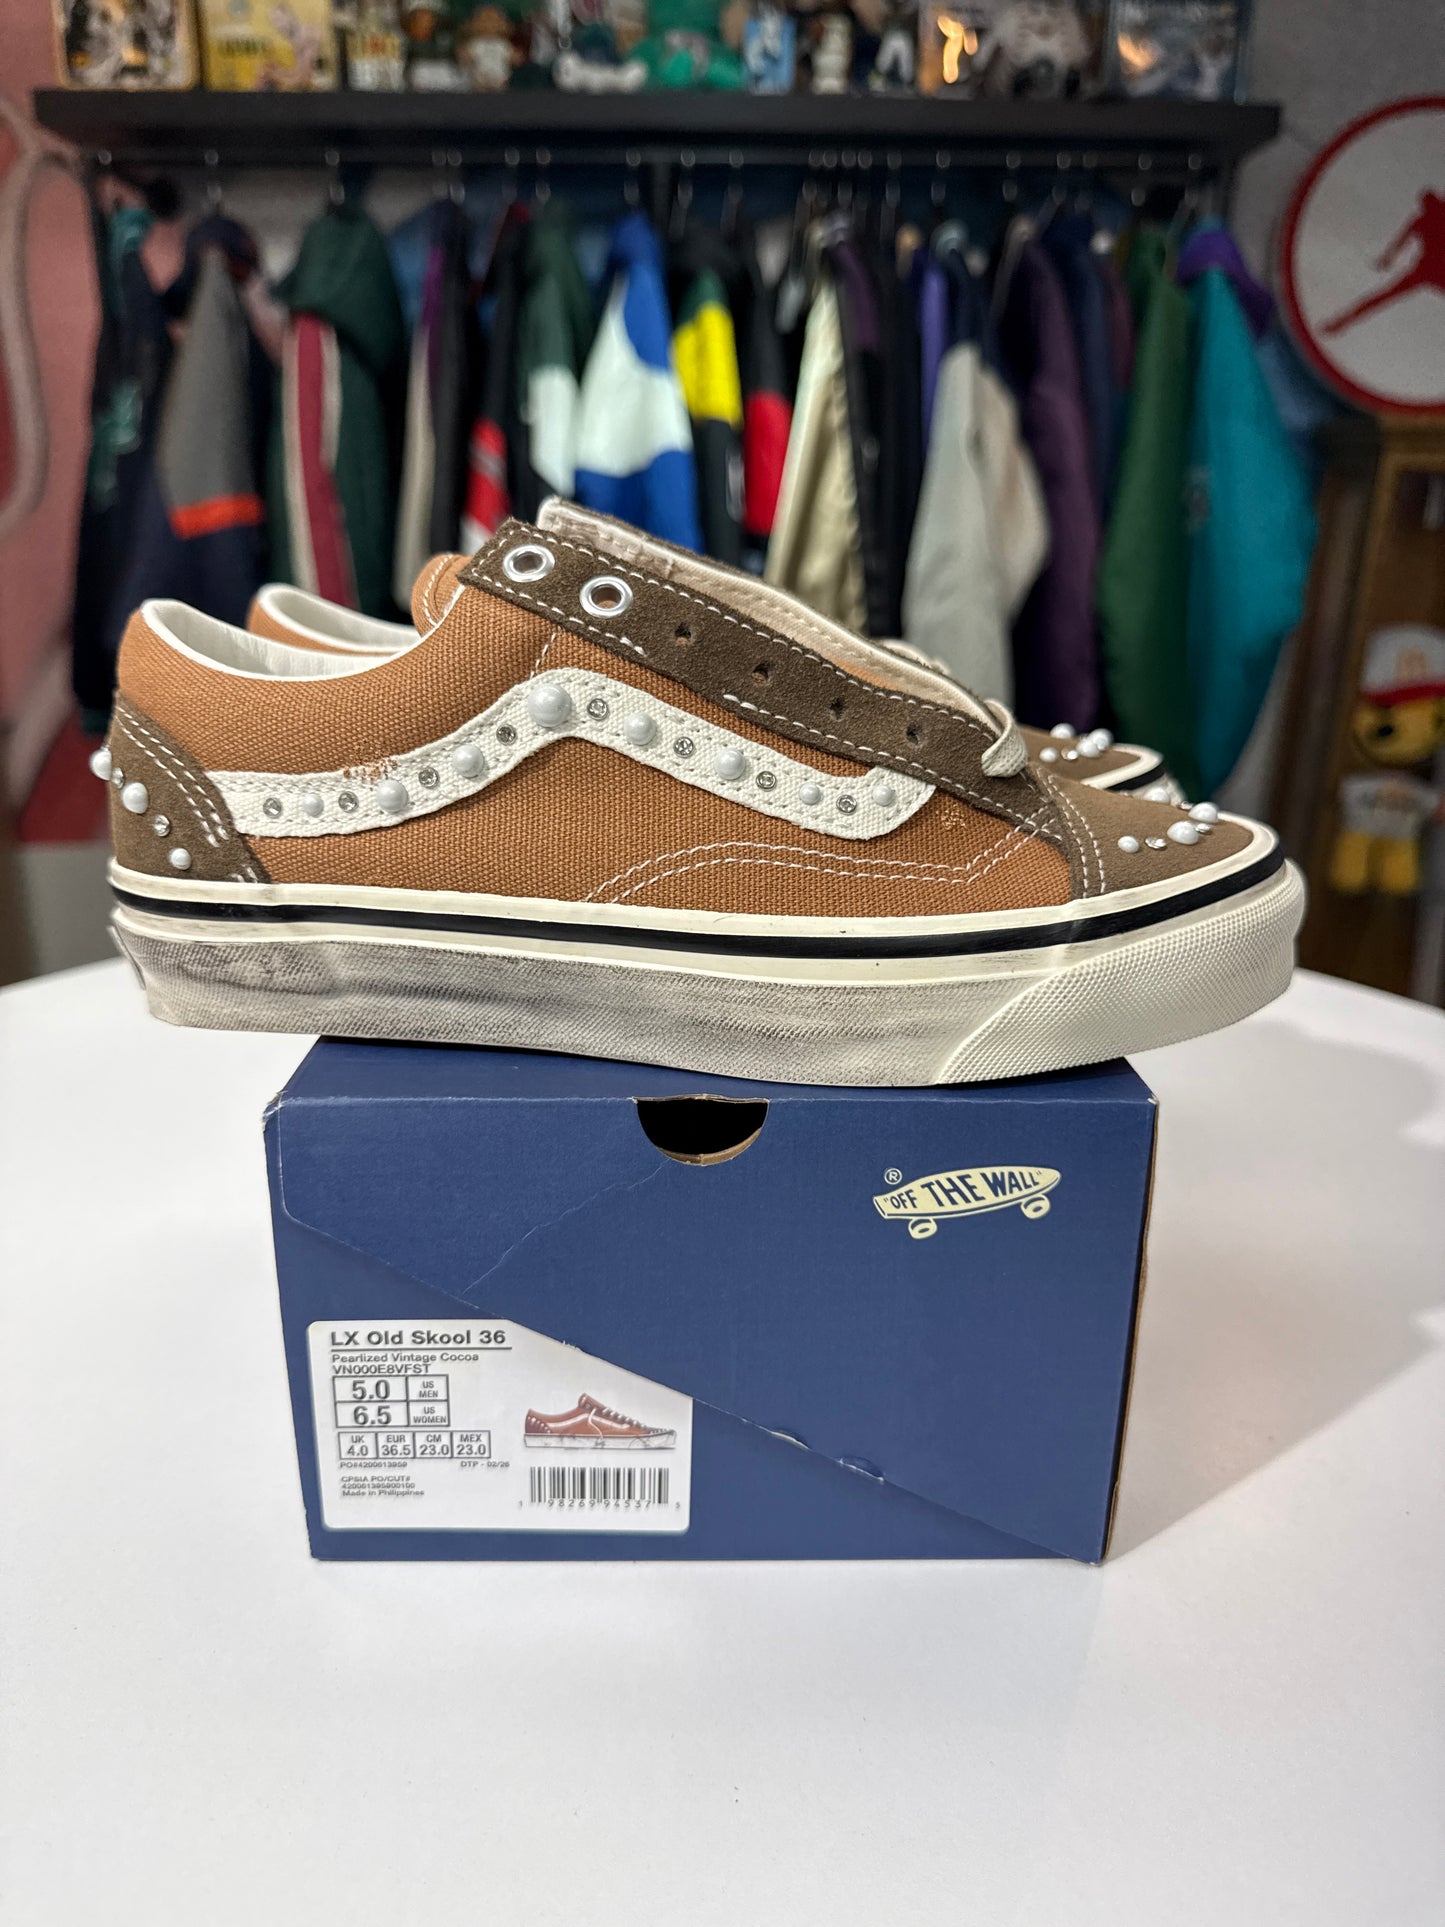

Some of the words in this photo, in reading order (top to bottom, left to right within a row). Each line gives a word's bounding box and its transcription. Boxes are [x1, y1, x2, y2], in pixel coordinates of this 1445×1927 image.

[921, 1174, 985, 1207] THE
[331, 1331, 359, 1345] LX
[367, 1330, 403, 1345] Old
[411, 1330, 471, 1345] Skool
[479, 1330, 506, 1344] 36
[332, 1354, 388, 1362] Pearlized
[392, 1353, 436, 1362] Vintage
[440, 1352, 479, 1361] Cocoa
[332, 1364, 431, 1374] VN000E8VFST
[352, 1380, 390, 1400] 5.0
[353, 1406, 391, 1425] 6.5
[460, 1434, 482, 1442] MEX
[347, 1445, 368, 1456] 4.0
[381, 1445, 411, 1455] 36.5
[419, 1444, 449, 1455] 23.0
[457, 1444, 486, 1455] 23.0
[379, 1489, 424, 1497] Philippines
